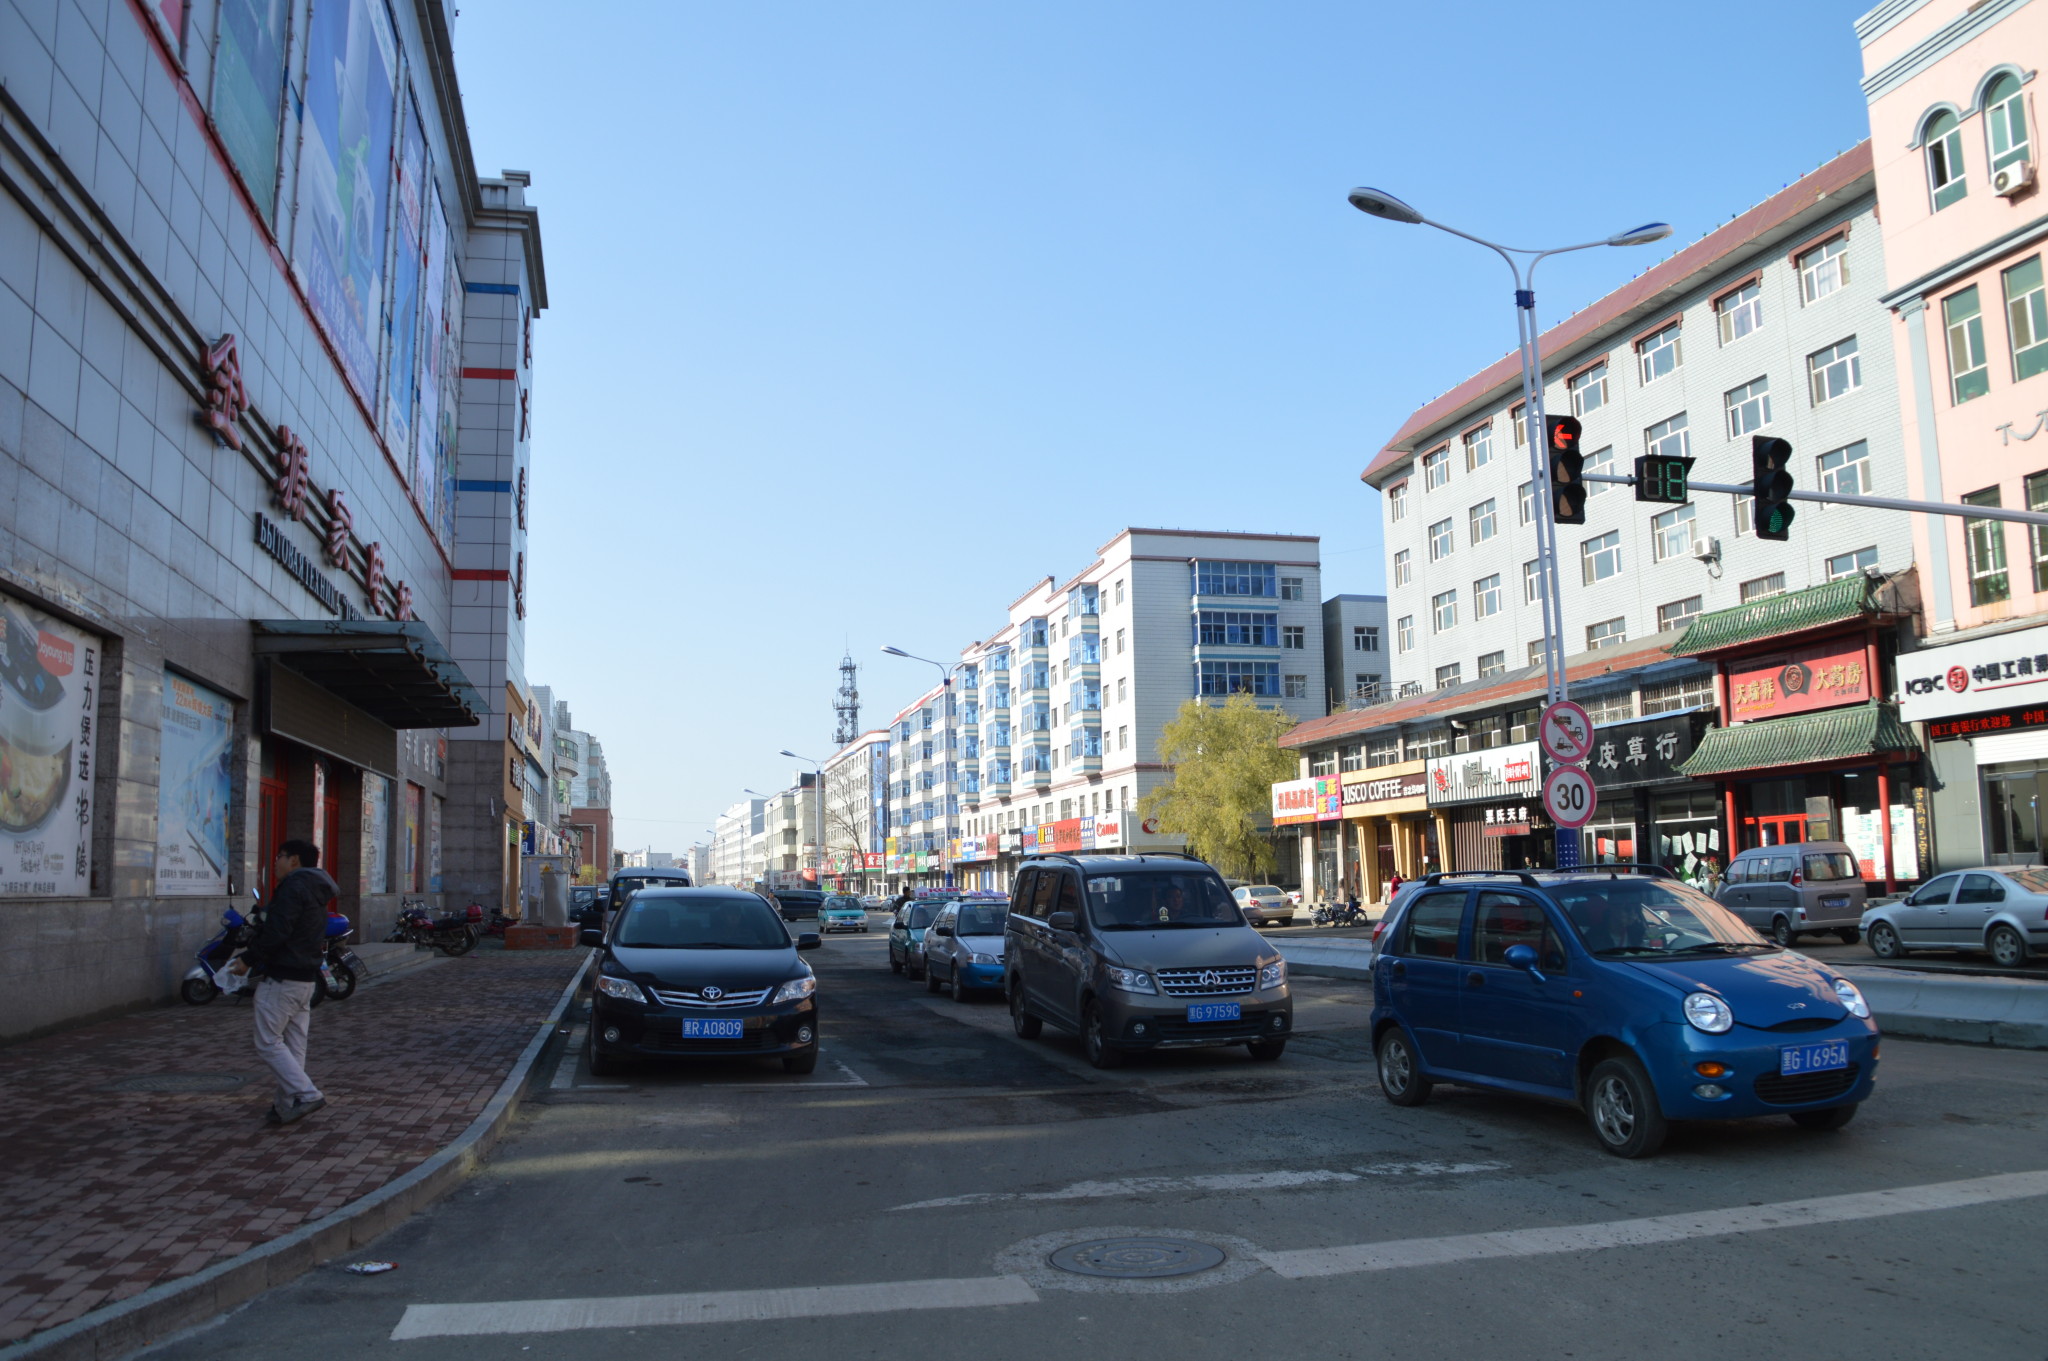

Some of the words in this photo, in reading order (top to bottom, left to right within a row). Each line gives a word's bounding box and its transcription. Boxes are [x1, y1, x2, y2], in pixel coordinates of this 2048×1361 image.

[38, 641, 62, 664] Joyoung
[1814, 661, 1862, 691] 大药房
[1905, 674, 1945, 696] ICBC
[1734, 677, 1776, 704] 天瑞祥
[1342, 783, 1368, 805] JUSCO
[1369, 779, 1402, 800] COFFEE
[1556, 783, 1585, 811] 30
